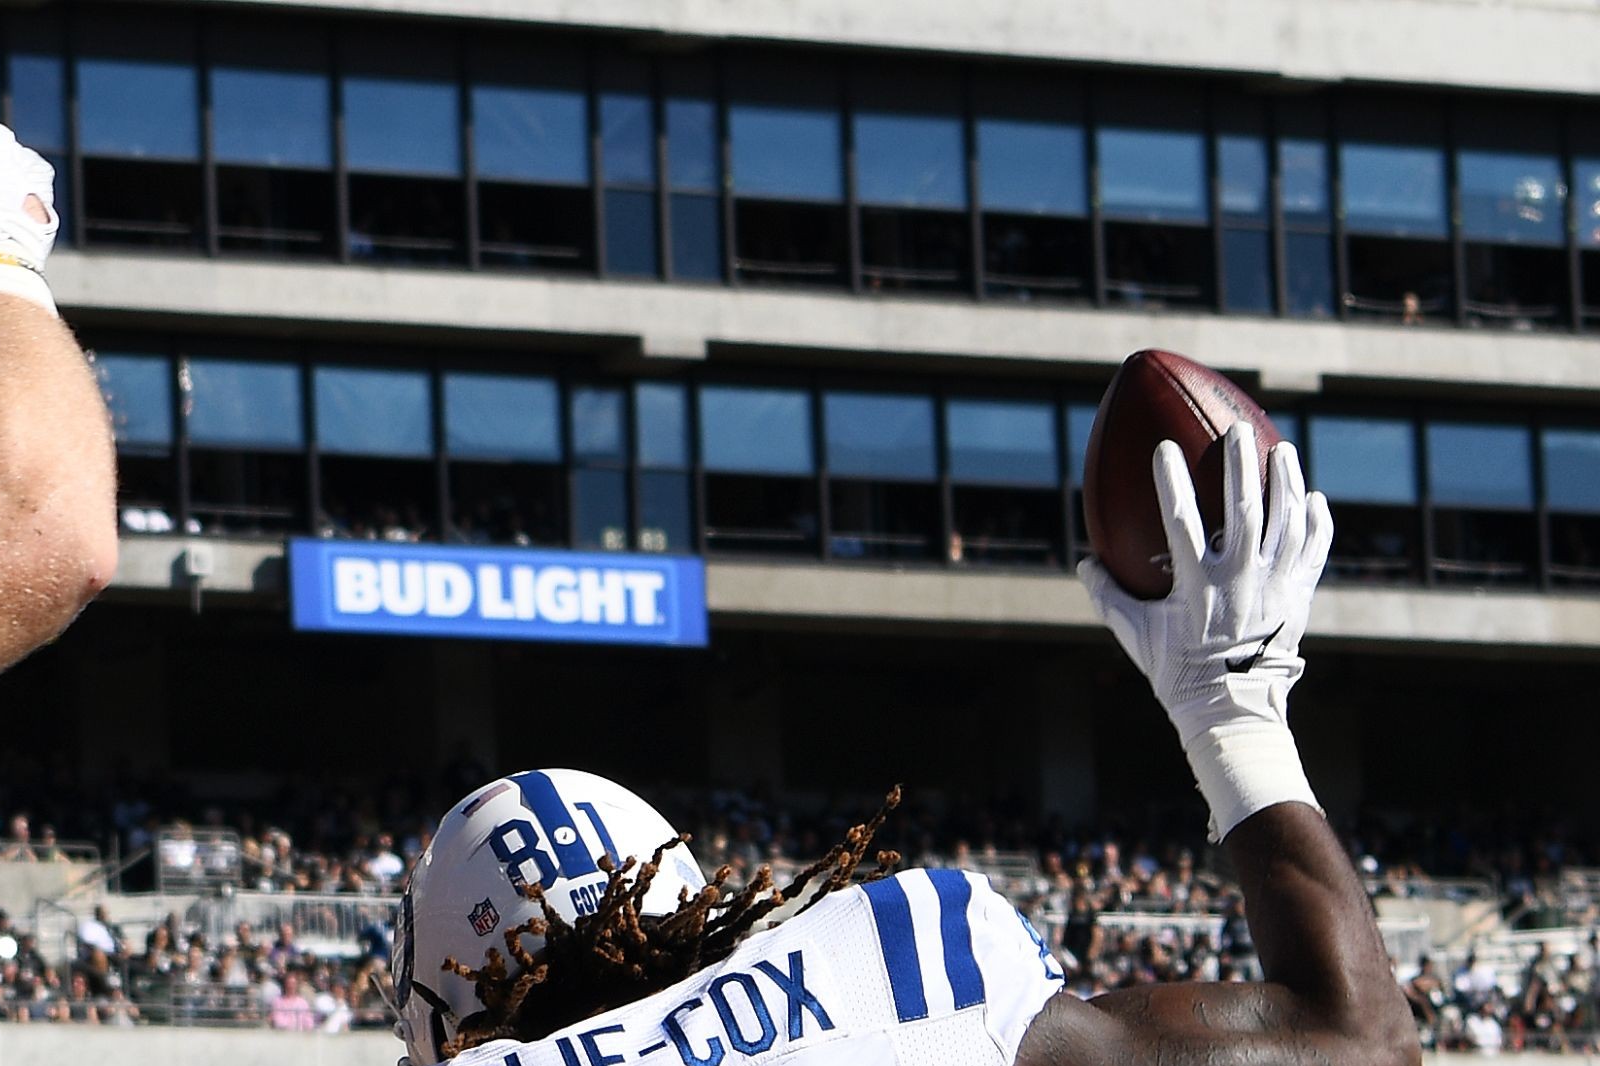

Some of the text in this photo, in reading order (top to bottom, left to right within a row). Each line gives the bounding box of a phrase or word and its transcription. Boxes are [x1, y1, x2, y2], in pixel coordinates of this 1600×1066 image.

[333, 556, 664, 625] BUD LIGHT
[489, 801, 623, 897] 81
